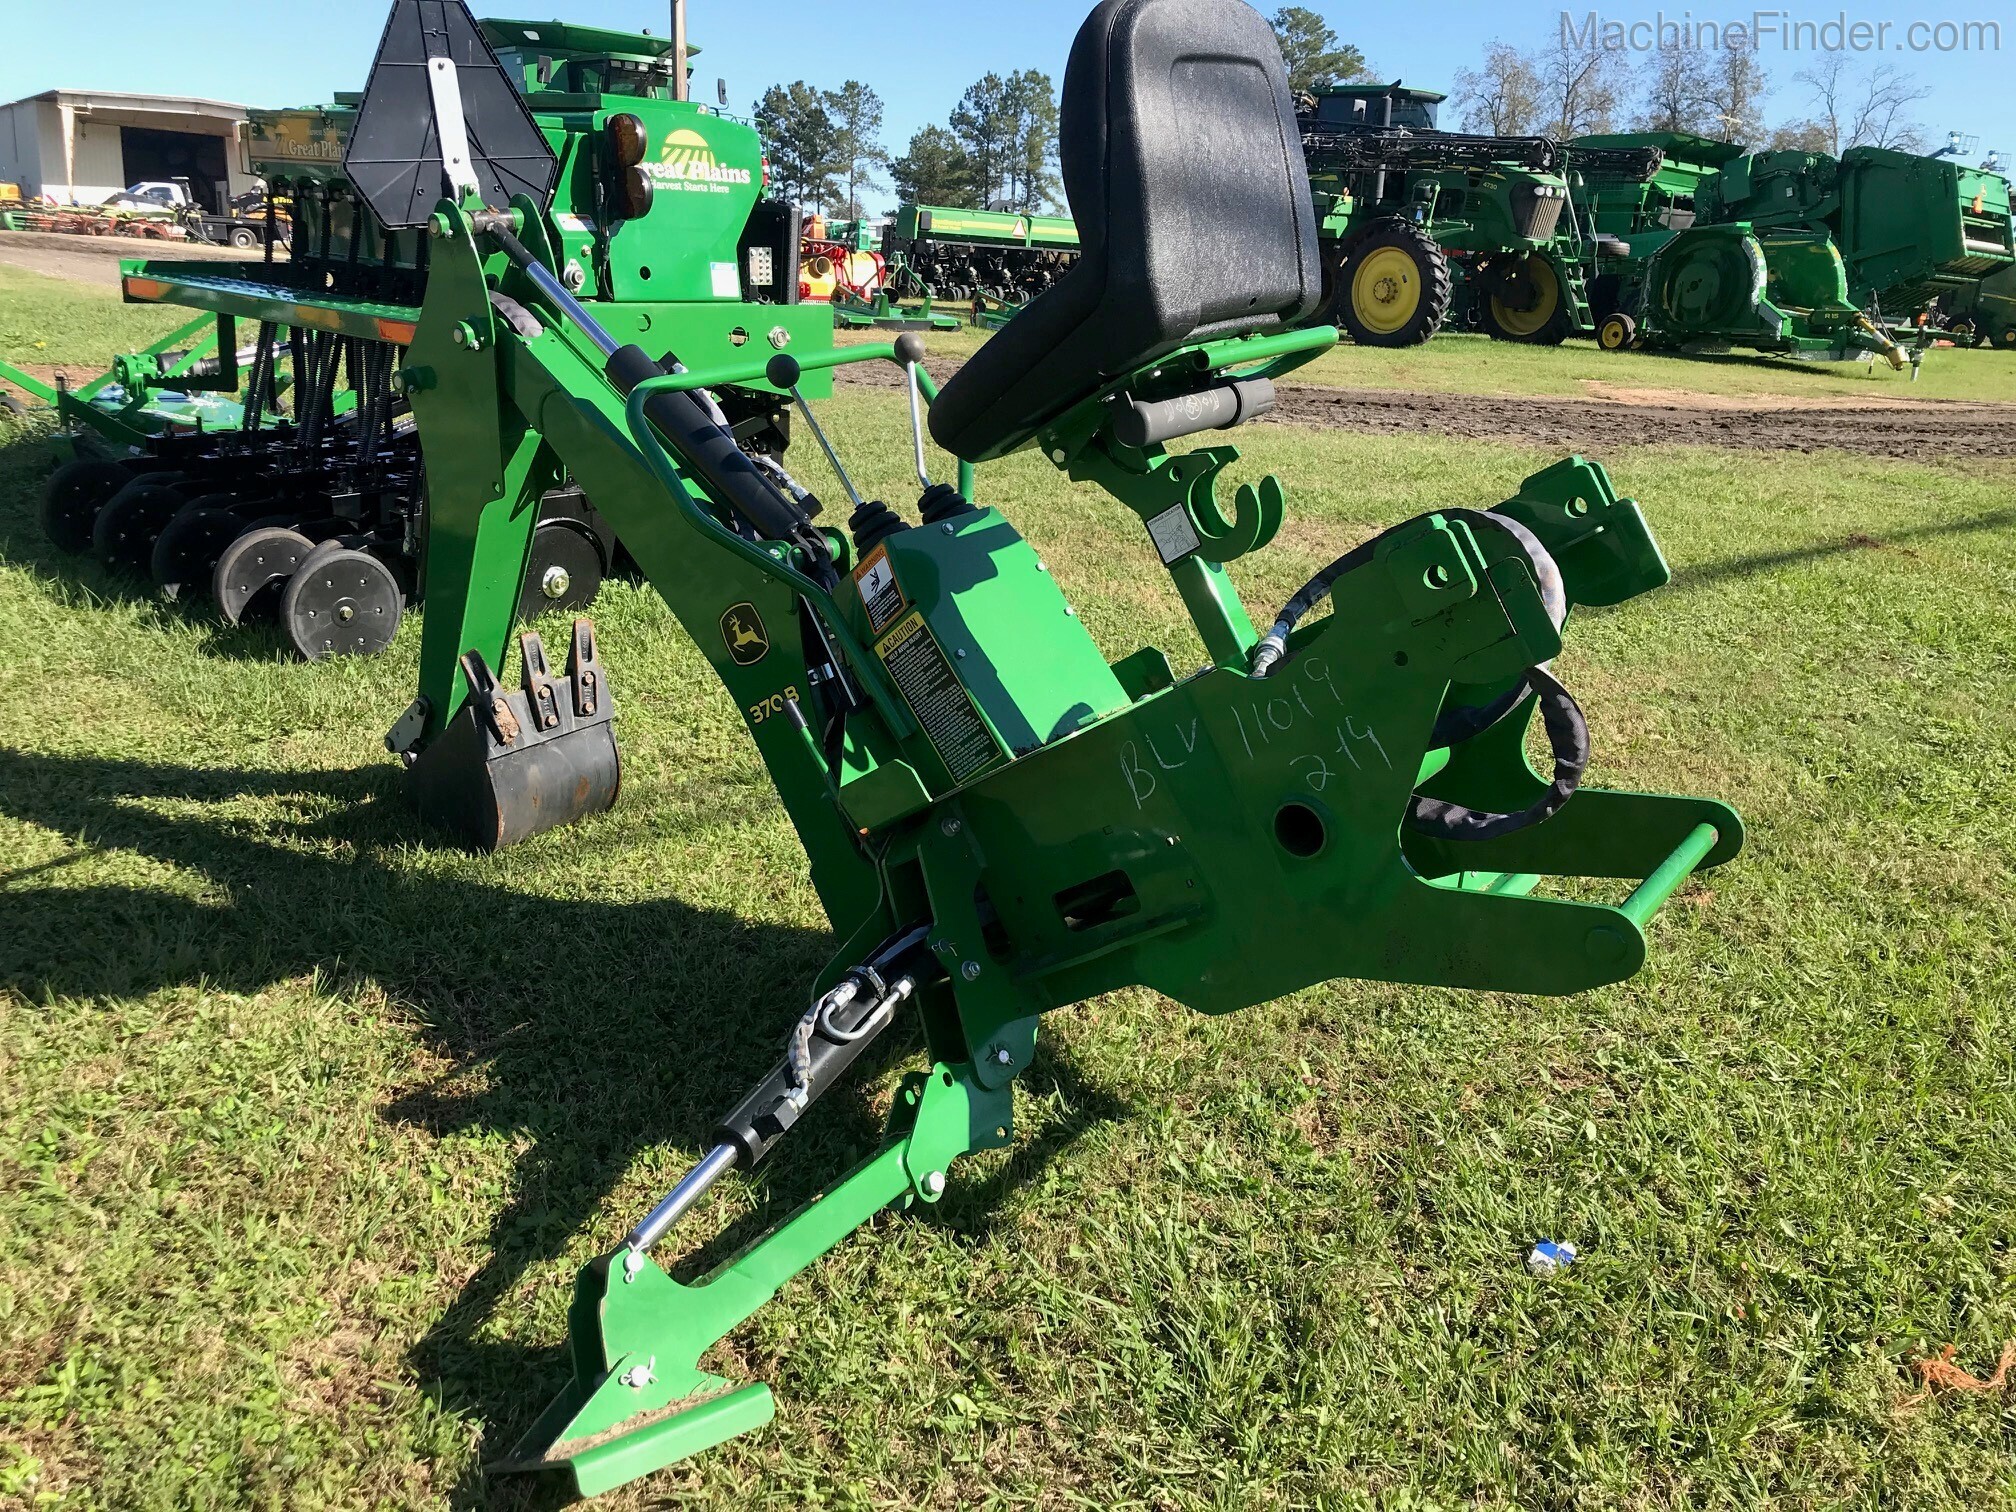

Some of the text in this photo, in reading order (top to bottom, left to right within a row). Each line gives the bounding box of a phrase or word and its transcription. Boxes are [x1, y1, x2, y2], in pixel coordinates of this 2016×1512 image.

[288, 138, 320, 156] Great
[636, 160, 751, 184] reat Plains
[683, 181, 709, 193] Starts
[709, 182, 730, 194] Here
[860, 547, 884, 574] WARNING
[887, 617, 919, 648] CAUTION
[888, 650, 899, 661] HELP
